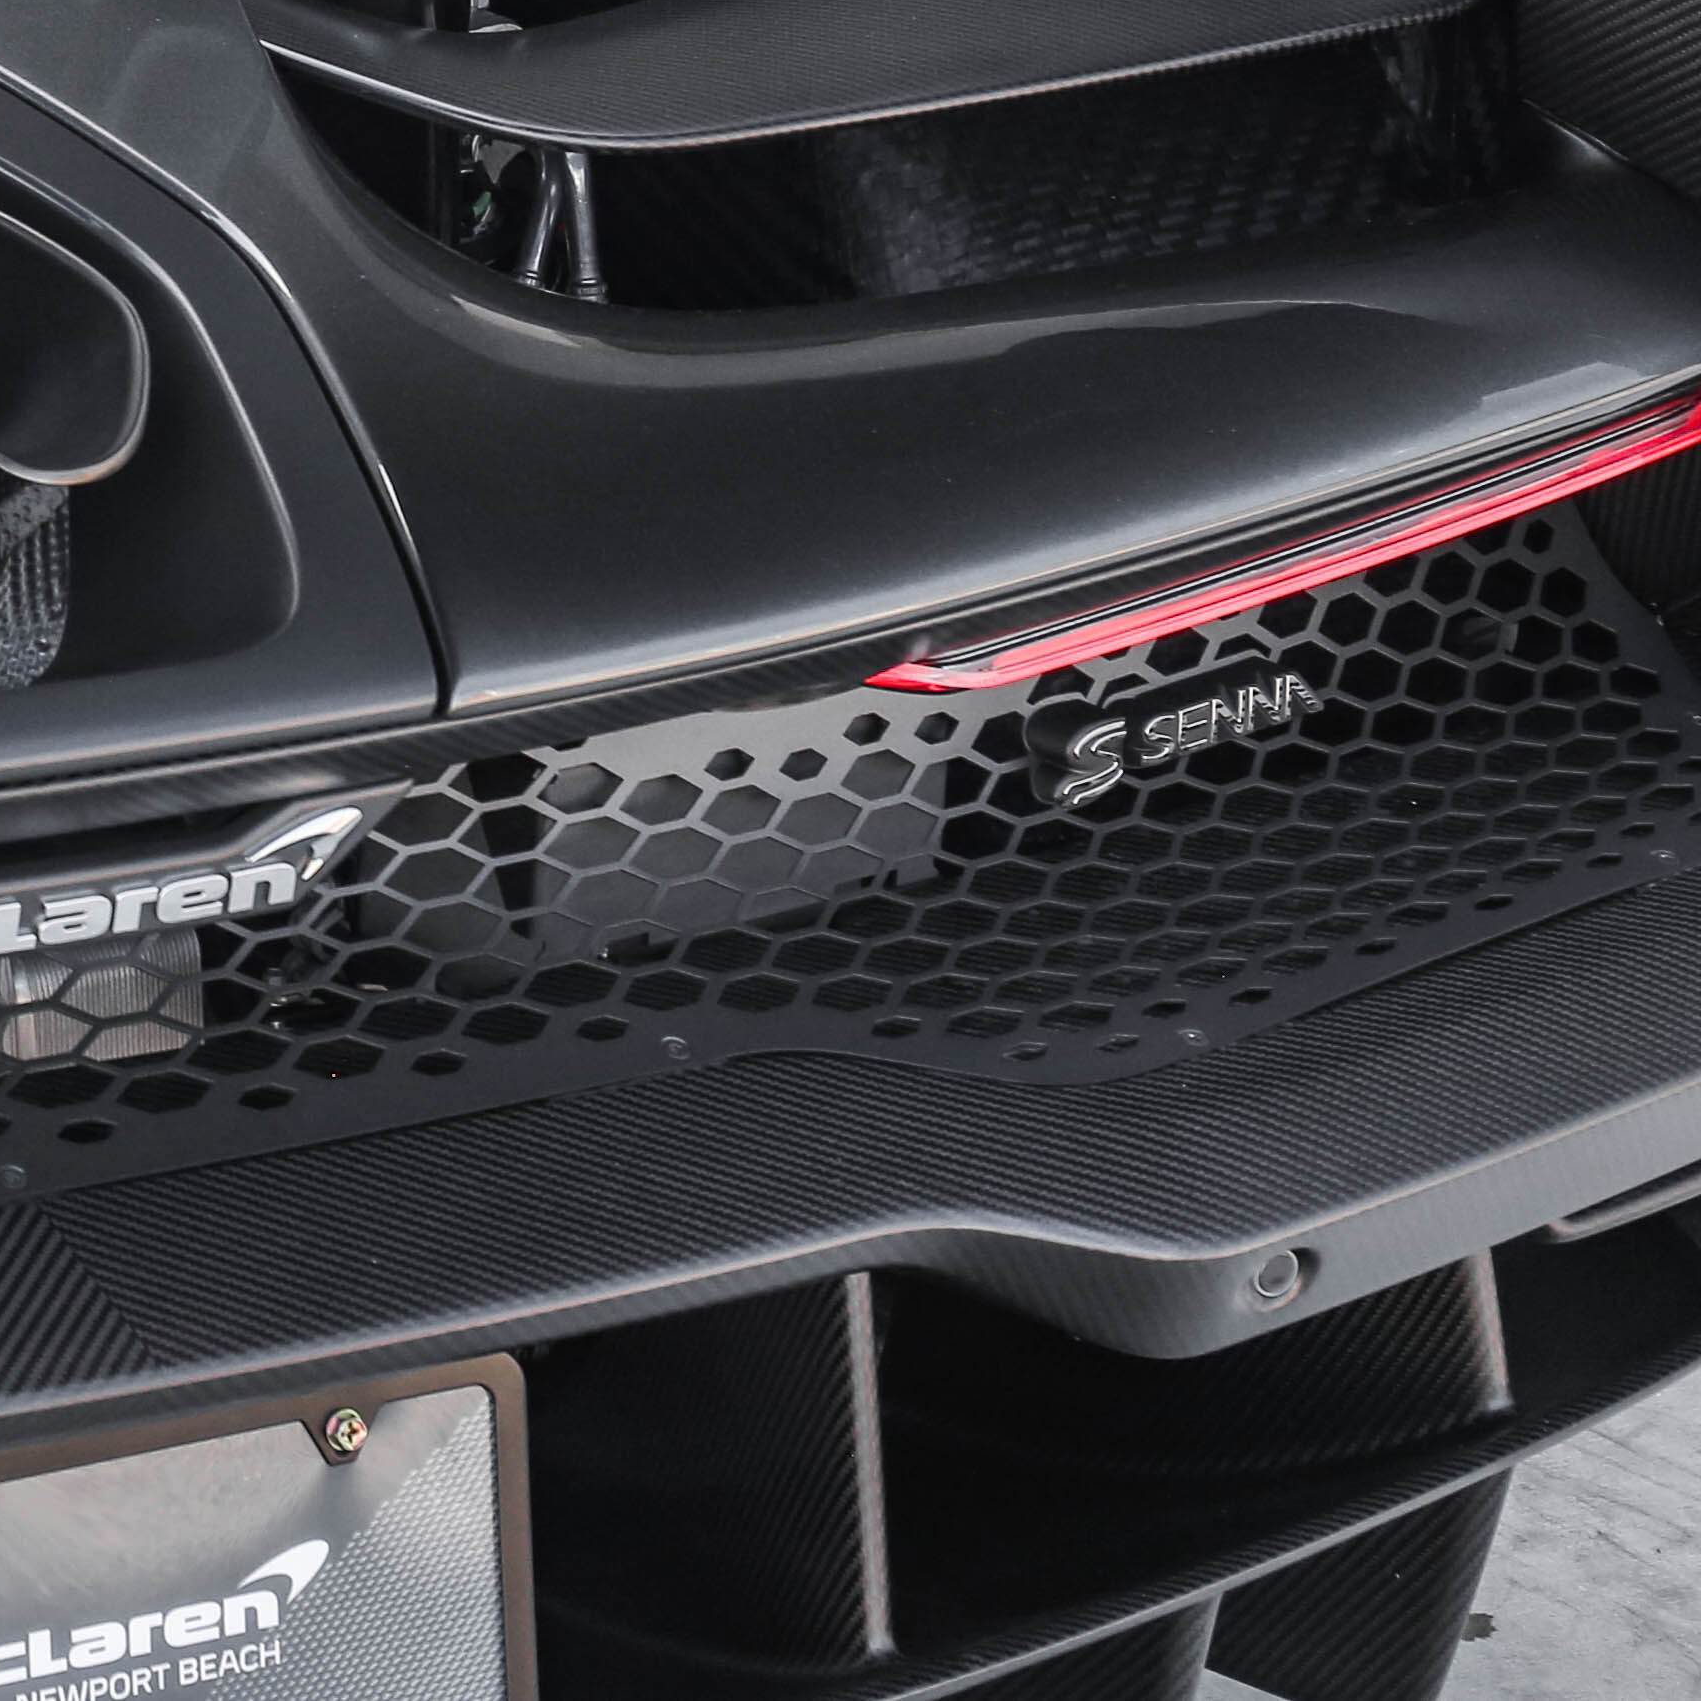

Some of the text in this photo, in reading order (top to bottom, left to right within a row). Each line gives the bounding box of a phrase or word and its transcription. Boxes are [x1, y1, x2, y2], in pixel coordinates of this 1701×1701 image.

[1141, 674, 1323, 765] SENNA
[15, 1640, 282, 1701] WPORT BEACH
